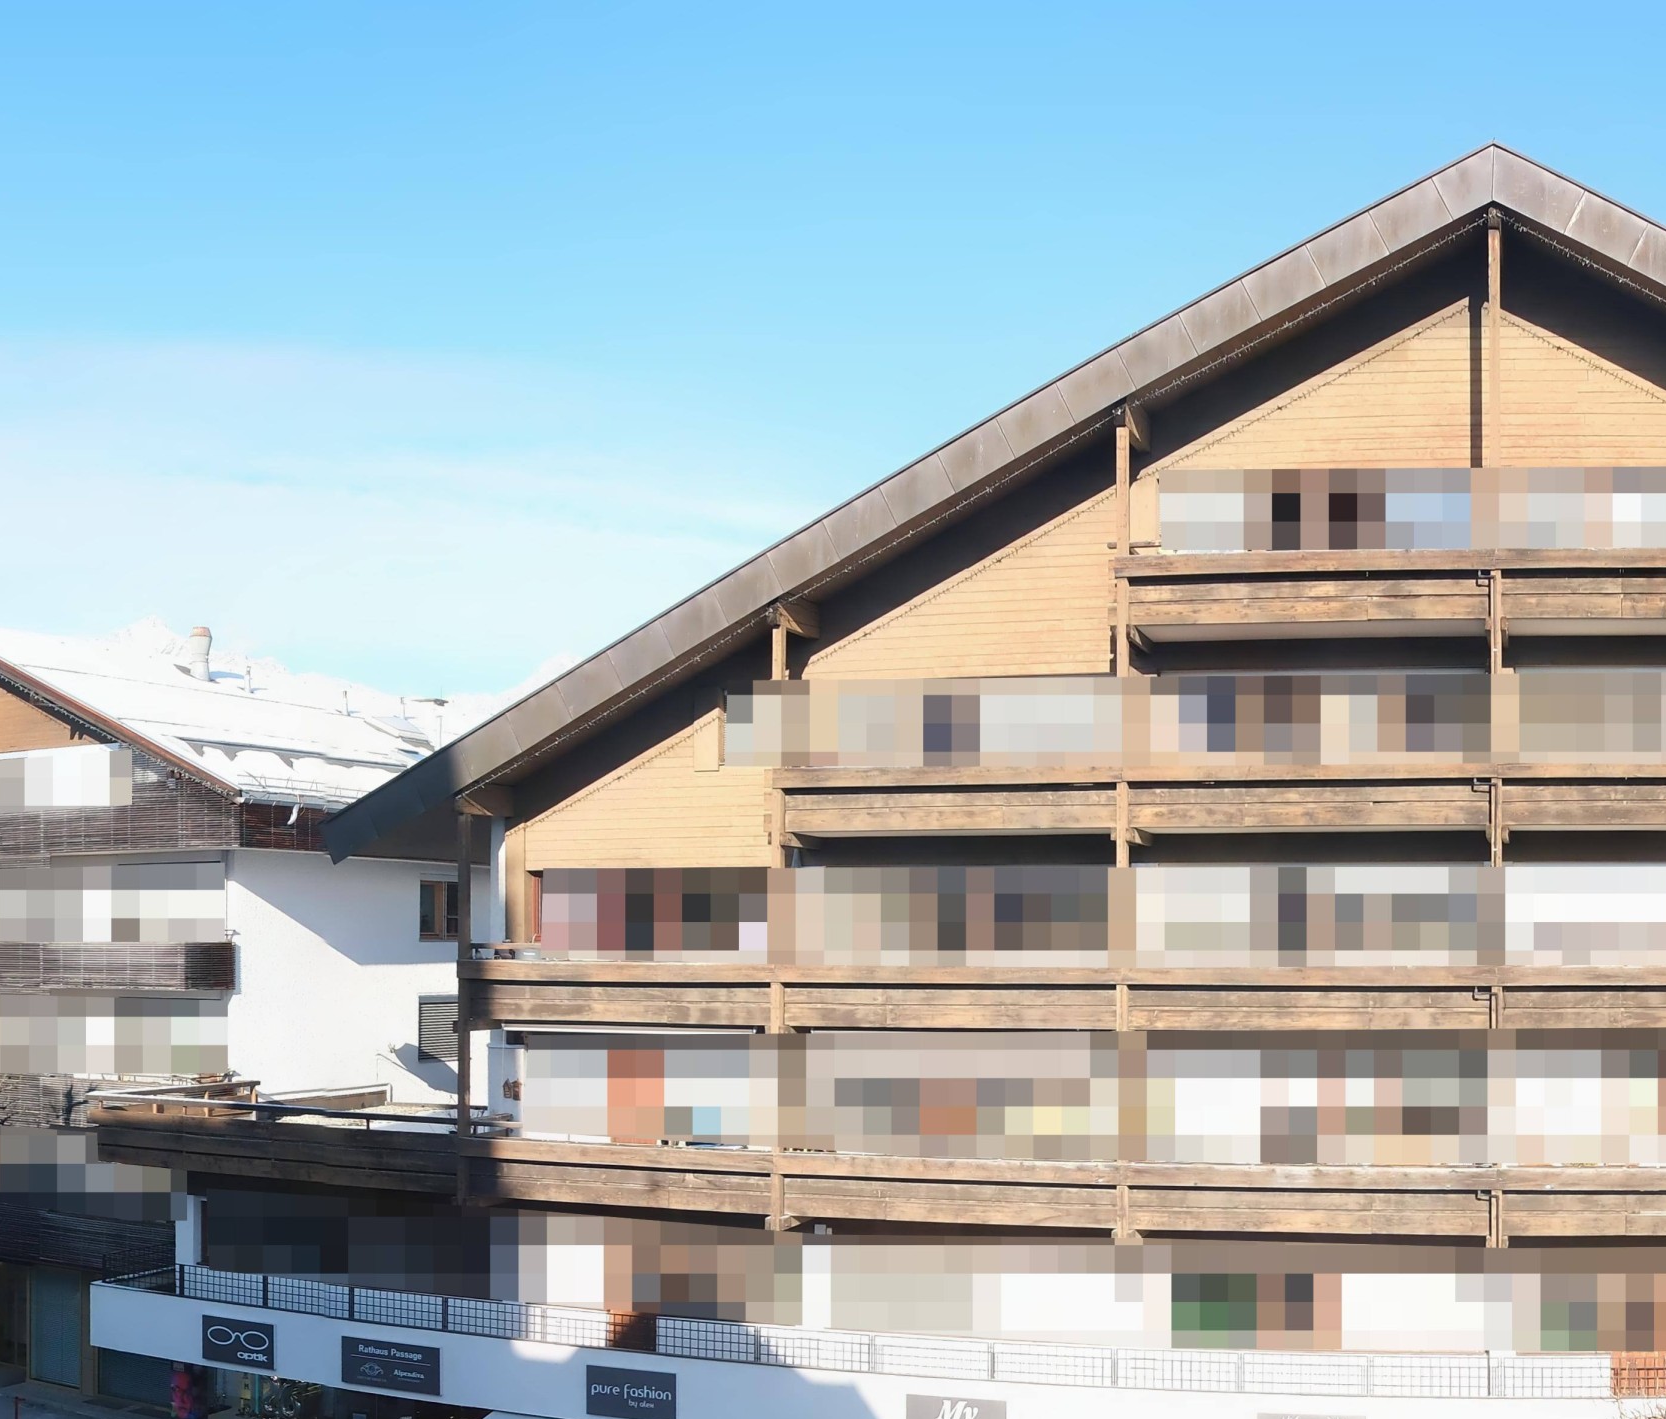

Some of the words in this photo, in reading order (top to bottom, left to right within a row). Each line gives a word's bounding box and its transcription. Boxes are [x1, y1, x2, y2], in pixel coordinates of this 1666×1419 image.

[237, 1351, 269, 1363] optik
[358, 1344, 389, 1356] Rathaus
[391, 1348, 422, 1361] Passage
[591, 1384, 620, 1396] pure
[623, 1383, 672, 1401] fashion
[628, 1399, 638, 1409] by
